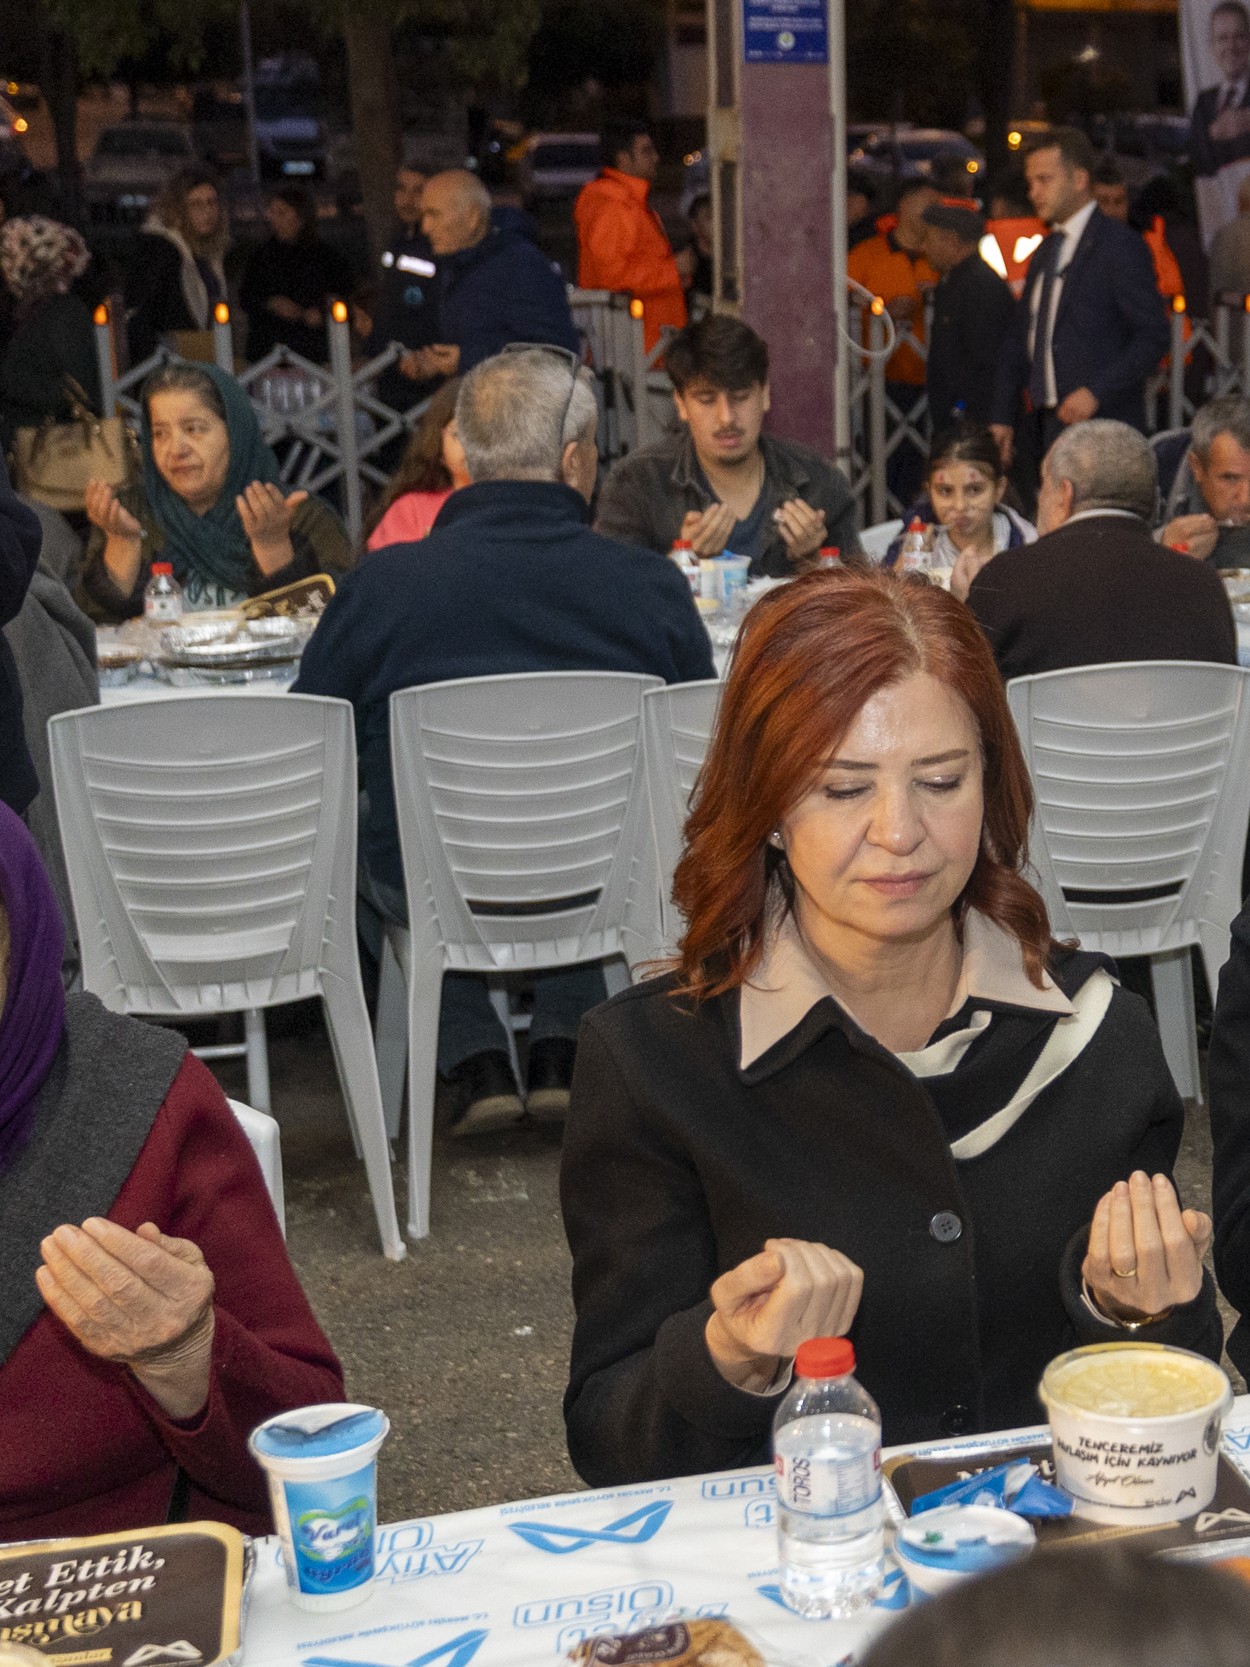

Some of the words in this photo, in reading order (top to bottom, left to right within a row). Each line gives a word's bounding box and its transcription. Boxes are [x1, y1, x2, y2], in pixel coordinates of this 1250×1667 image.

[1079, 1436, 1164, 1455] TENCEREMİZ
[1104, 1454, 1131, 1468] İÇİN
[1137, 1448, 1198, 1467] KAYNIYOR
[793, 1456, 812, 1503] TOROS
[44, 1544, 166, 1589] Ettik,
[518, 1583, 668, 1627] Olsun
